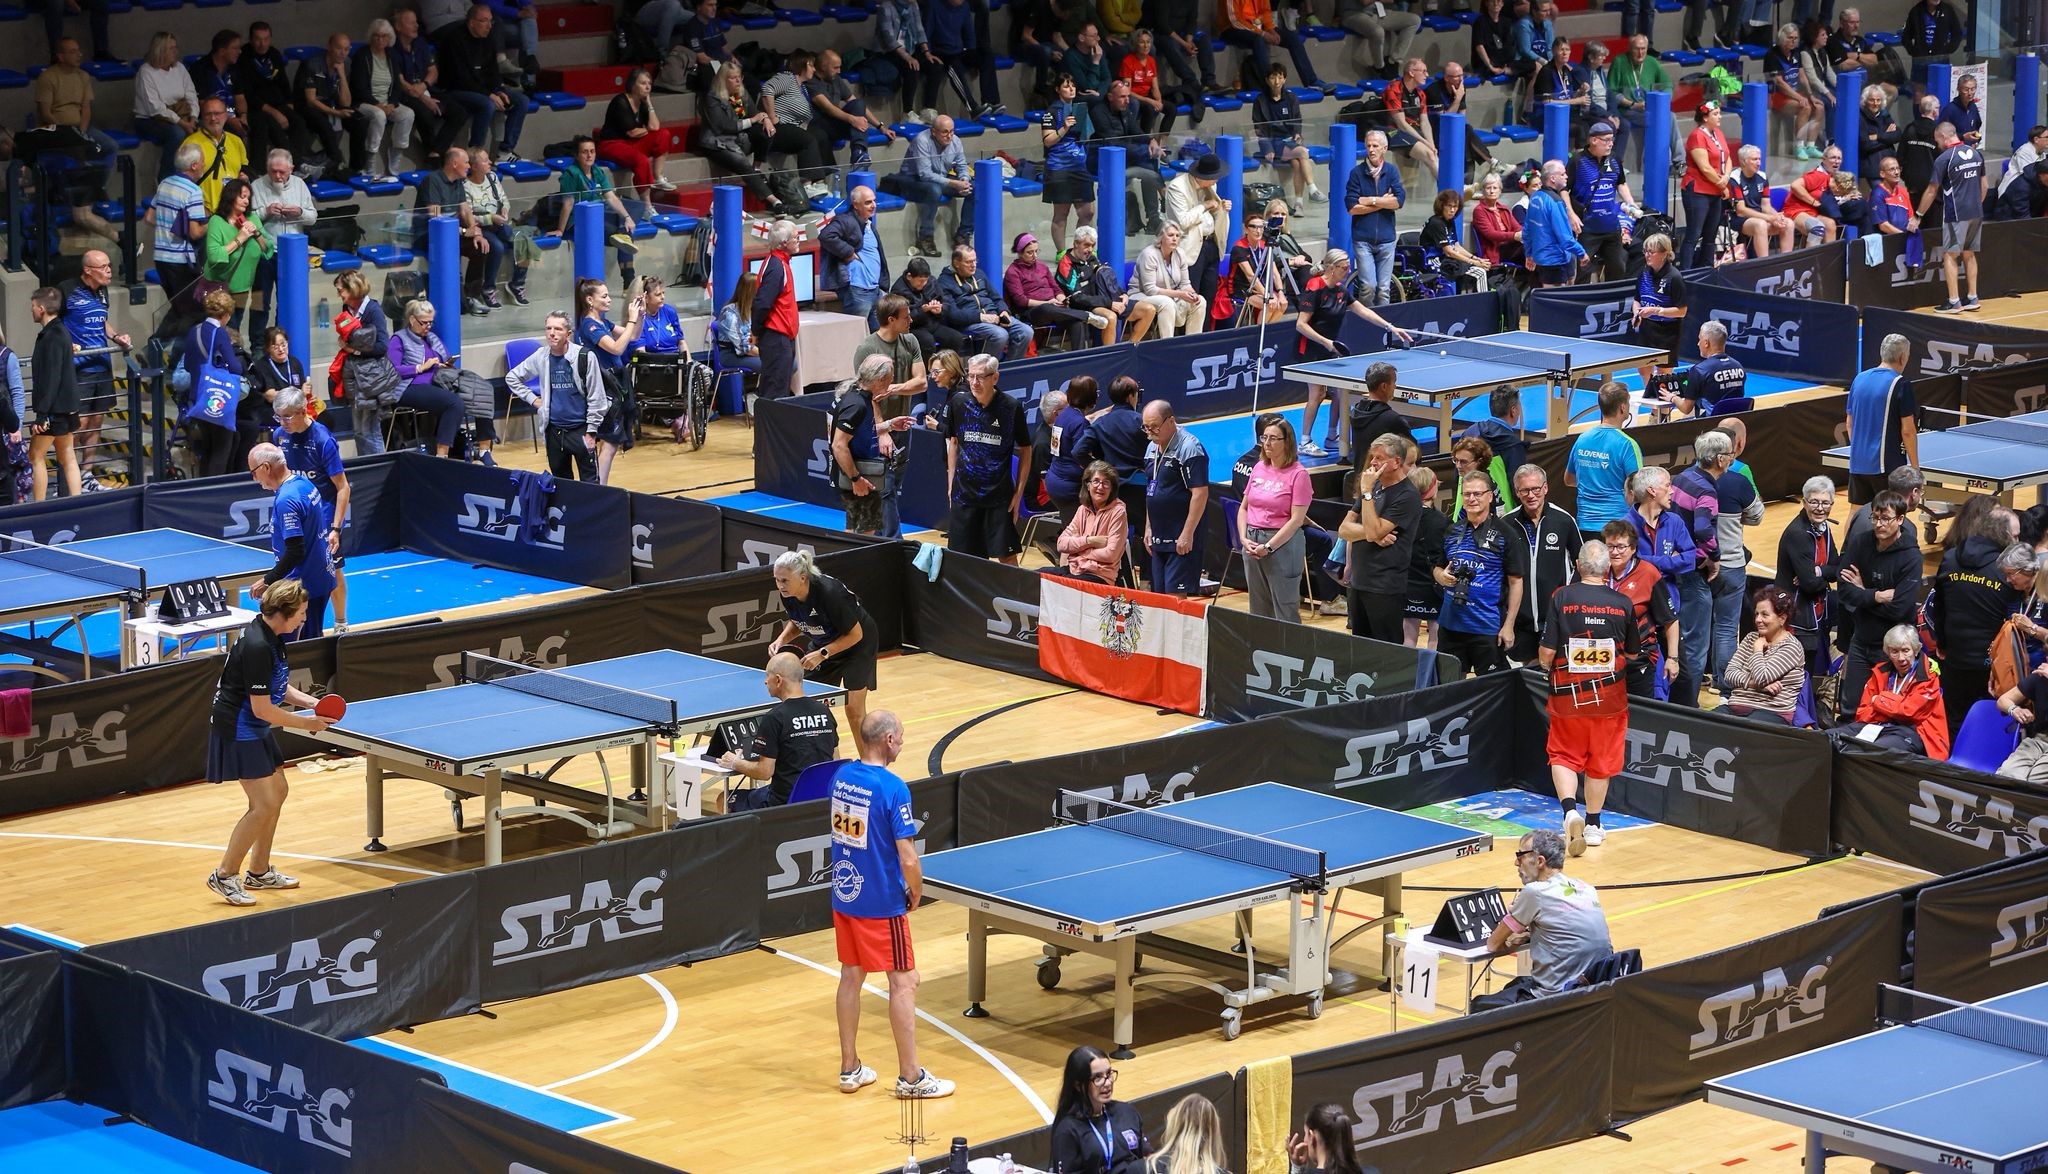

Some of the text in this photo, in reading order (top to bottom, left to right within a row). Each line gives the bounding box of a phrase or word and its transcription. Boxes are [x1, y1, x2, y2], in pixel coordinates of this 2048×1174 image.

[1964, 170, 1978, 179] USA
[1590, 183, 1613, 192] SADA
[1186, 347, 1277, 396] STAG
[1714, 368, 1745, 382] GEWO
[1401, 391, 1419, 400] STAG
[1233, 461, 1253, 477] COAC
[1966, 478, 1989, 489] STAG
[1949, 572, 1959, 582] TG
[1960, 572, 1986, 585] Ardorf
[1404, 604, 1439, 614] JOOLA
[1563, 604, 1626, 617] PPP SwissTeam
[1584, 616, 1606, 625] Heinz
[142, 641, 151, 666] 3
[1573, 650, 1611, 663] 443
[792, 714, 828, 730] STAFF
[729, 721, 756, 745] 5 0 0
[682, 743, 687, 751] 7
[1335, 716, 1471, 790] STAG
[425, 758, 447, 773] STAG
[1624, 728, 1736, 802] TAG
[682, 780, 693, 807] 7
[842, 791, 871, 807] Championship
[834, 812, 861, 836] 211
[1456, 843, 1481, 858] STAG
[1457, 893, 1506, 926] 3 0 0 11
[493, 876, 665, 967] STAG
[1057, 921, 1084, 937] STAG
[202, 937, 378, 1015] STAG
[1407, 963, 1431, 999] 11
[1689, 965, 1829, 1061] STAG
[208, 1048, 354, 1158] STAG
[1350, 1050, 1519, 1151] STAG
[1938, 1153, 1974, 1170] STAG
